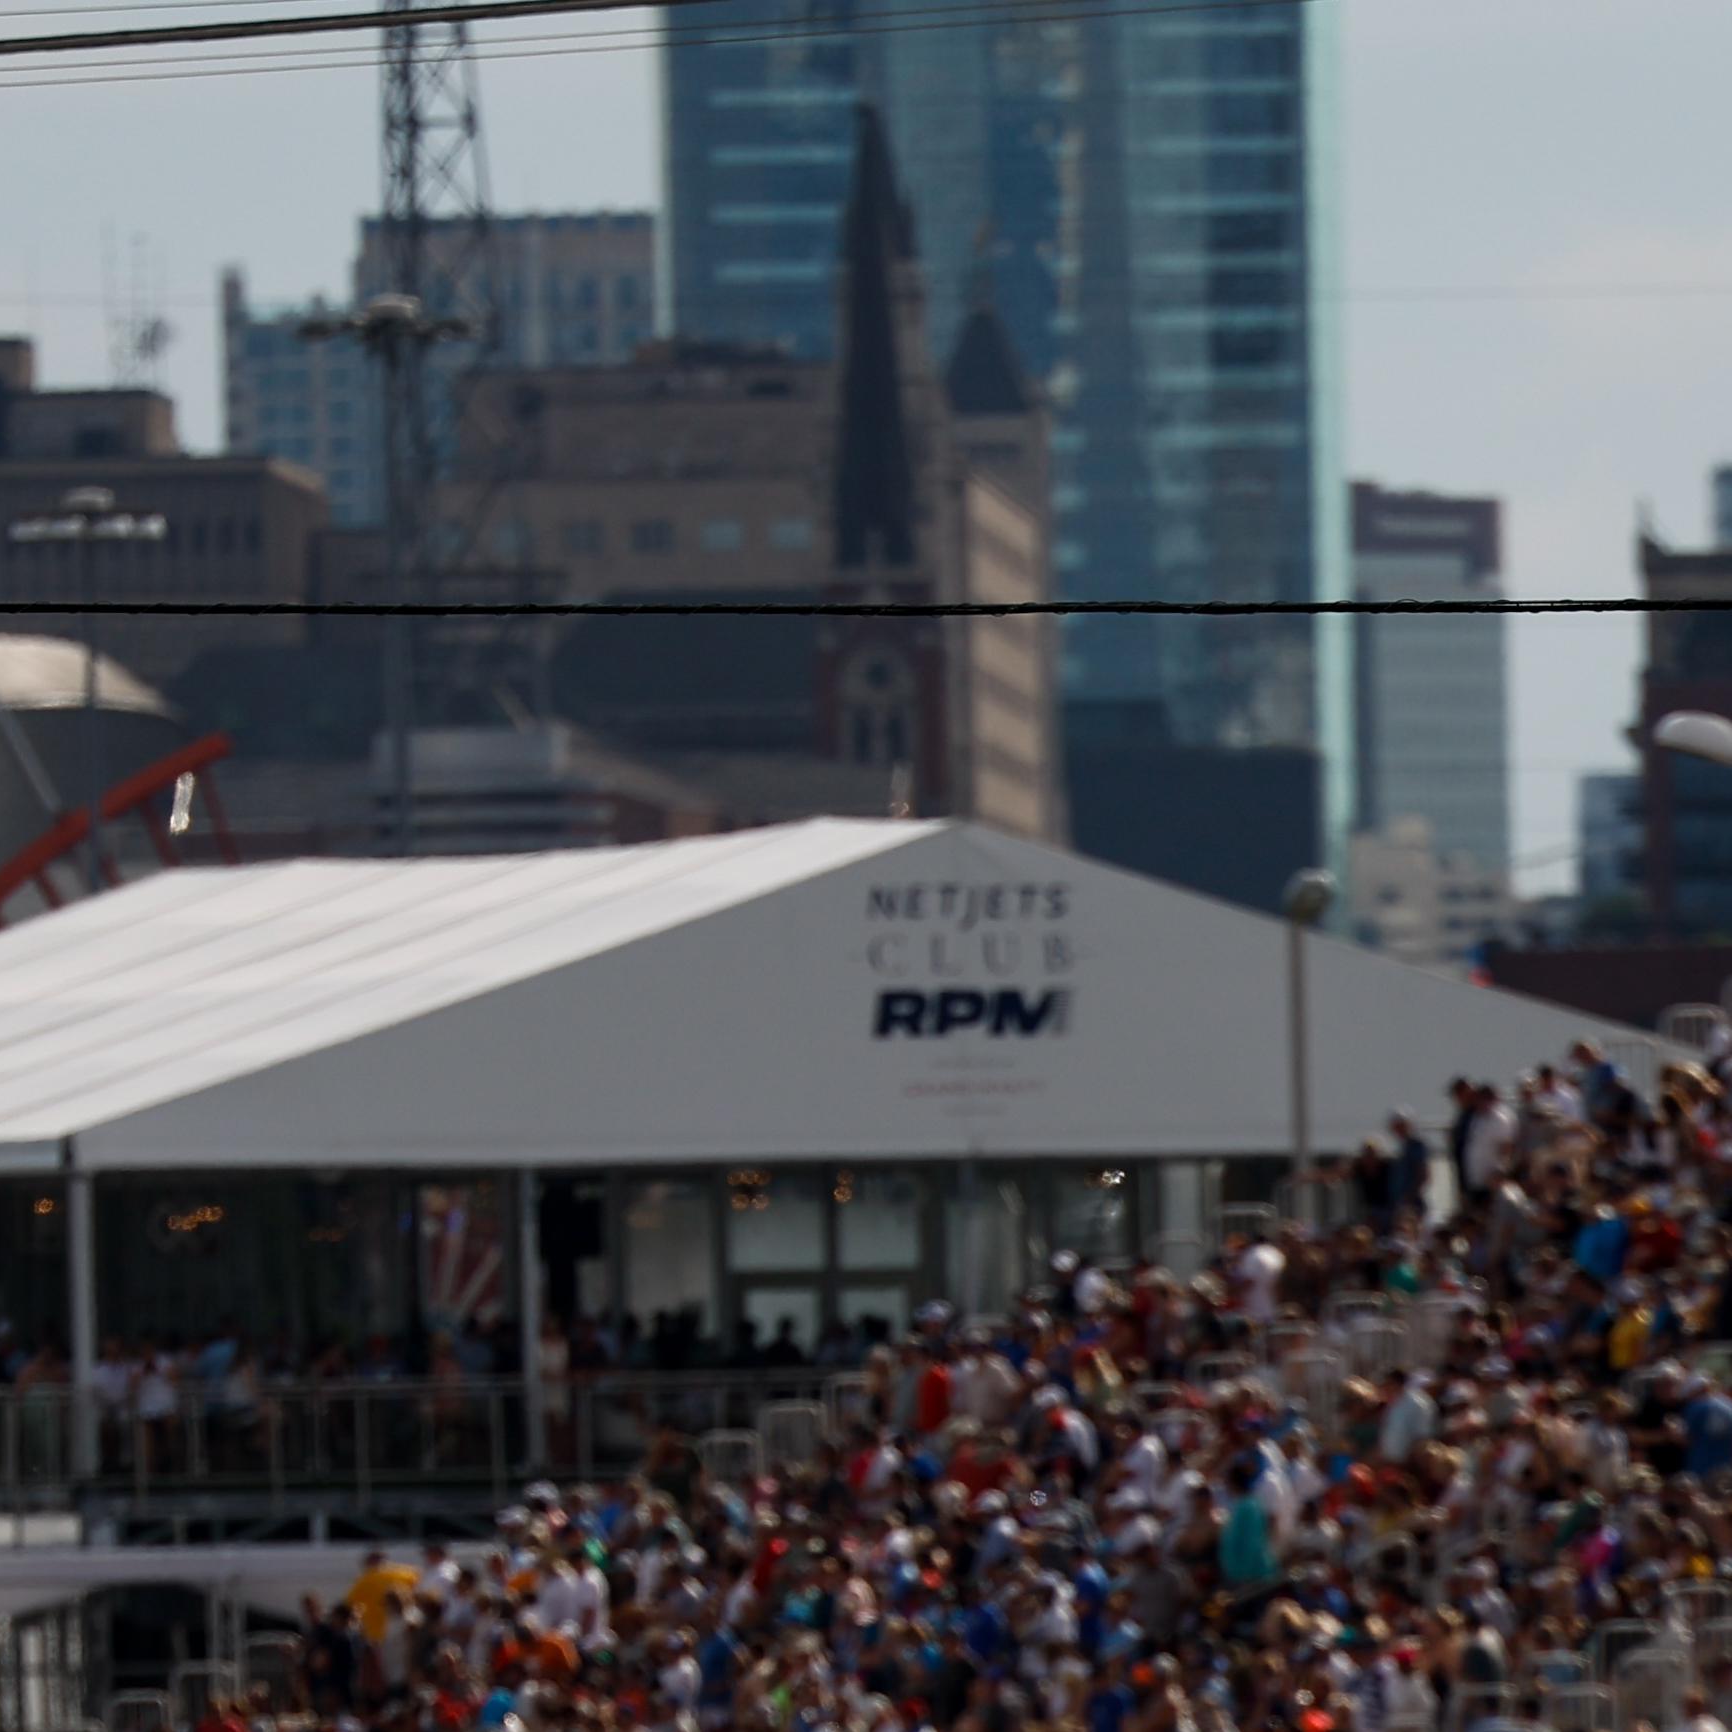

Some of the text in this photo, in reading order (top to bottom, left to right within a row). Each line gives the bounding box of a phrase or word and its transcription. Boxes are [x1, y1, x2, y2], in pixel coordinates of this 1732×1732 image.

[866, 884, 1073, 930] NETJETS
[866, 934, 1075, 976] CLUB
[872, 989, 1072, 1040] RPM
